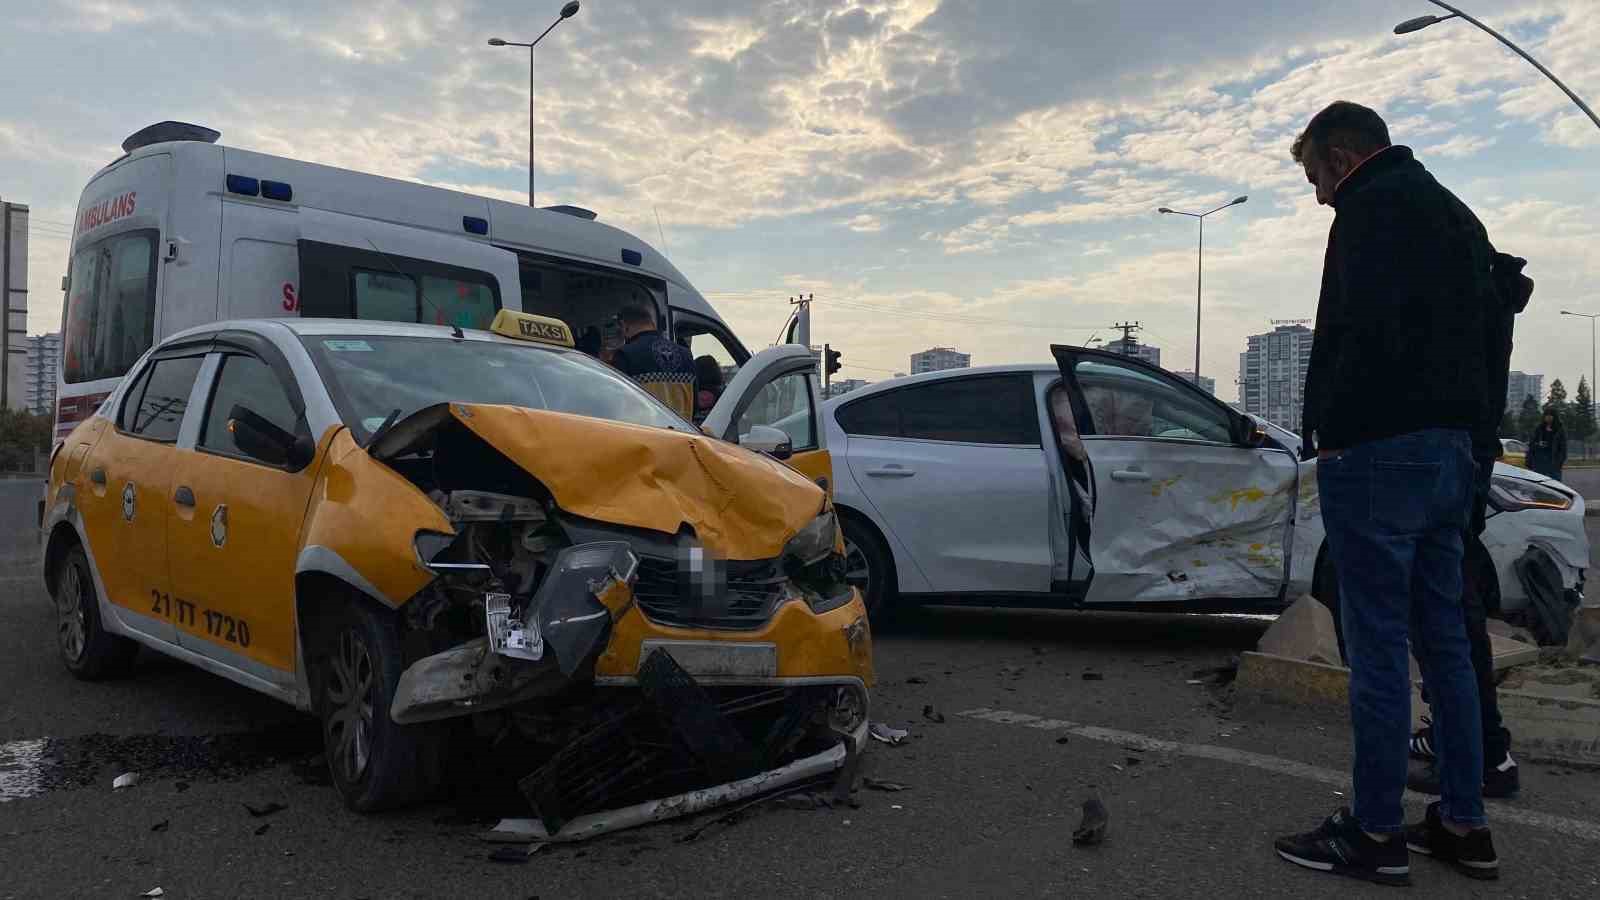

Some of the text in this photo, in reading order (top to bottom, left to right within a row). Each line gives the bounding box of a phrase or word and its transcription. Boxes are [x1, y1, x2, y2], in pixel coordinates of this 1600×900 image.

[151, 589, 250, 648] 21 TT 1720
